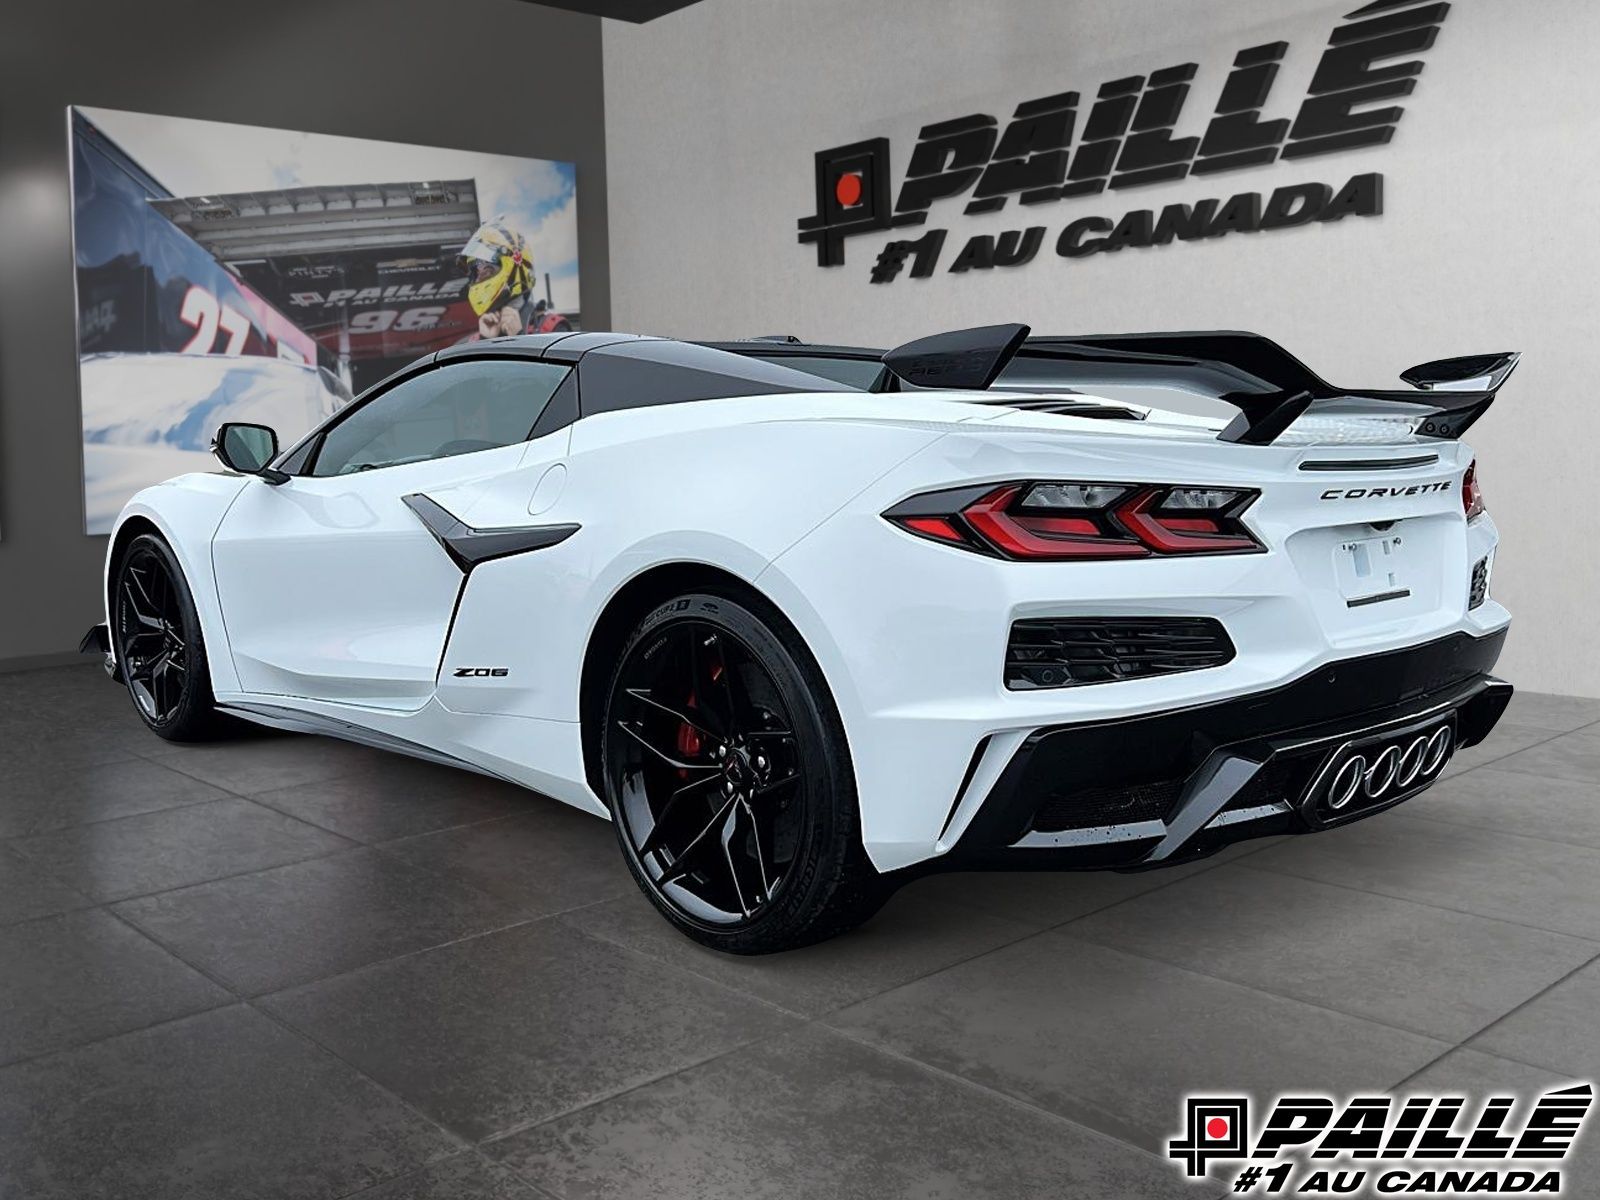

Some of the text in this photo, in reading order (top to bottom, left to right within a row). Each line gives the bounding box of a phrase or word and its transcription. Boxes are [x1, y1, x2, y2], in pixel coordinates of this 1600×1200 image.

[870, 172, 1383, 284] #1 AU CANADA
[179, 284, 251, 357] 27
[348, 306, 447, 334] 96
[1320, 480, 1452, 500] CORVETTE
[453, 667, 509, 678] Z06
